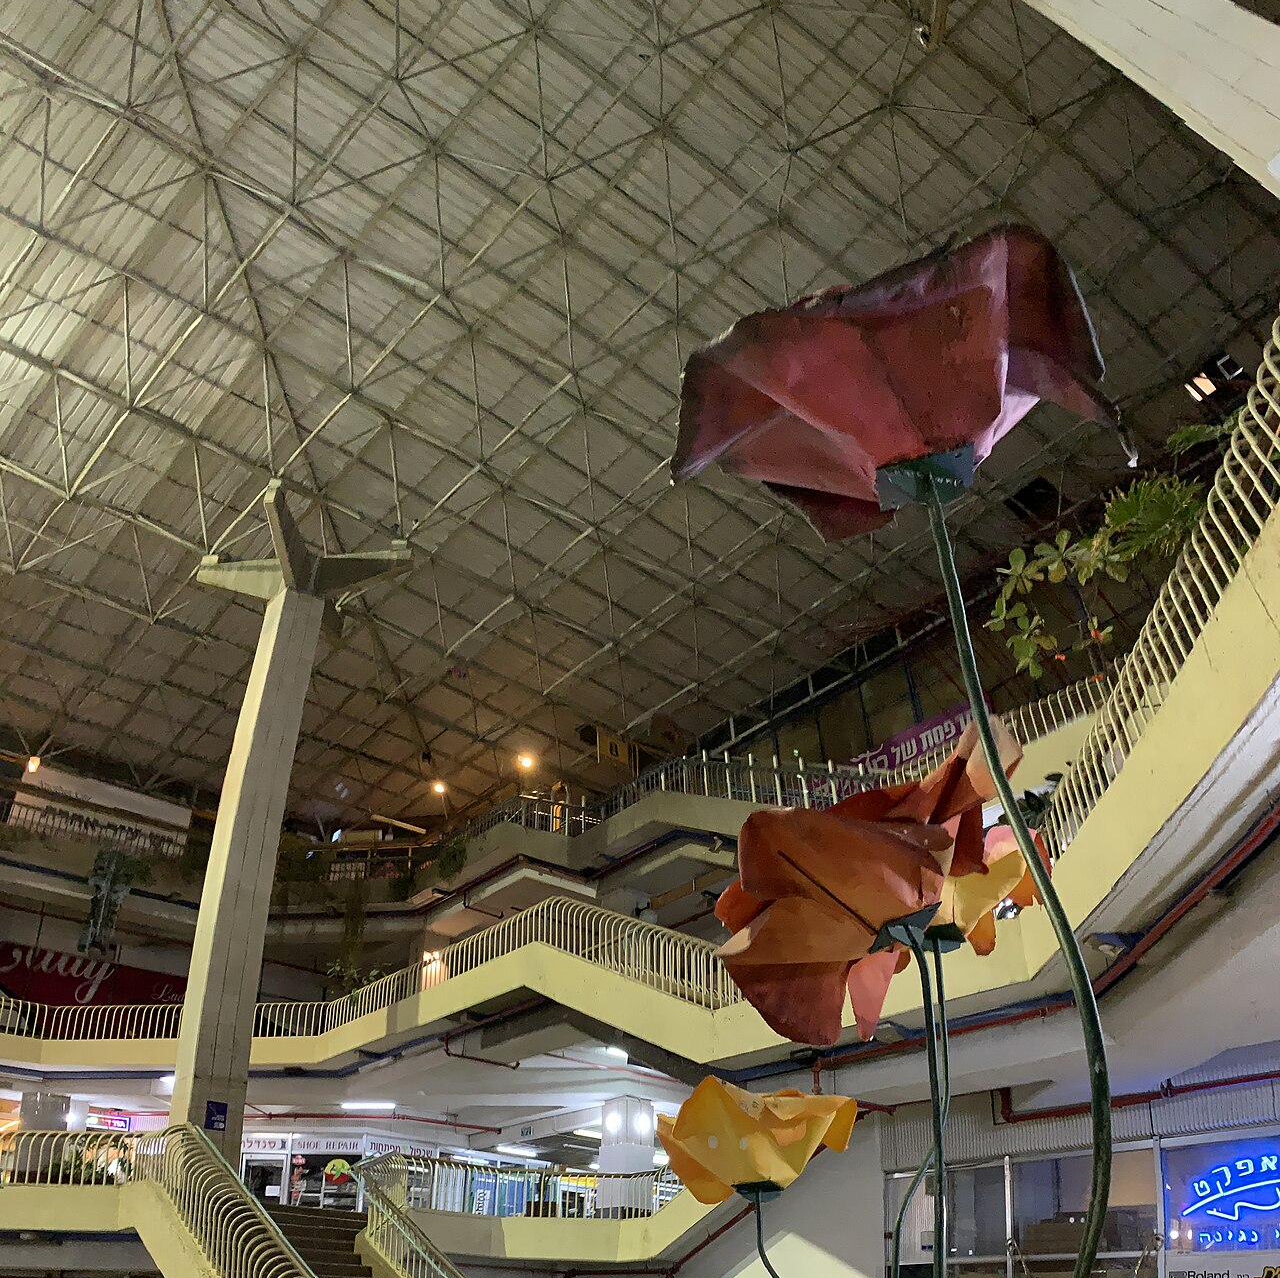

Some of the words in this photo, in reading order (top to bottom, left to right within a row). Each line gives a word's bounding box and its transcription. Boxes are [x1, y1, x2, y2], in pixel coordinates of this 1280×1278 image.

[891, 737, 918, 766] של
[298, 1141, 321, 1150] SHOE
[325, 1141, 359, 1150] REPAIR
[1193, 1155, 1278, 1196] אפקט
[1200, 1229, 1259, 1243] נגינה
